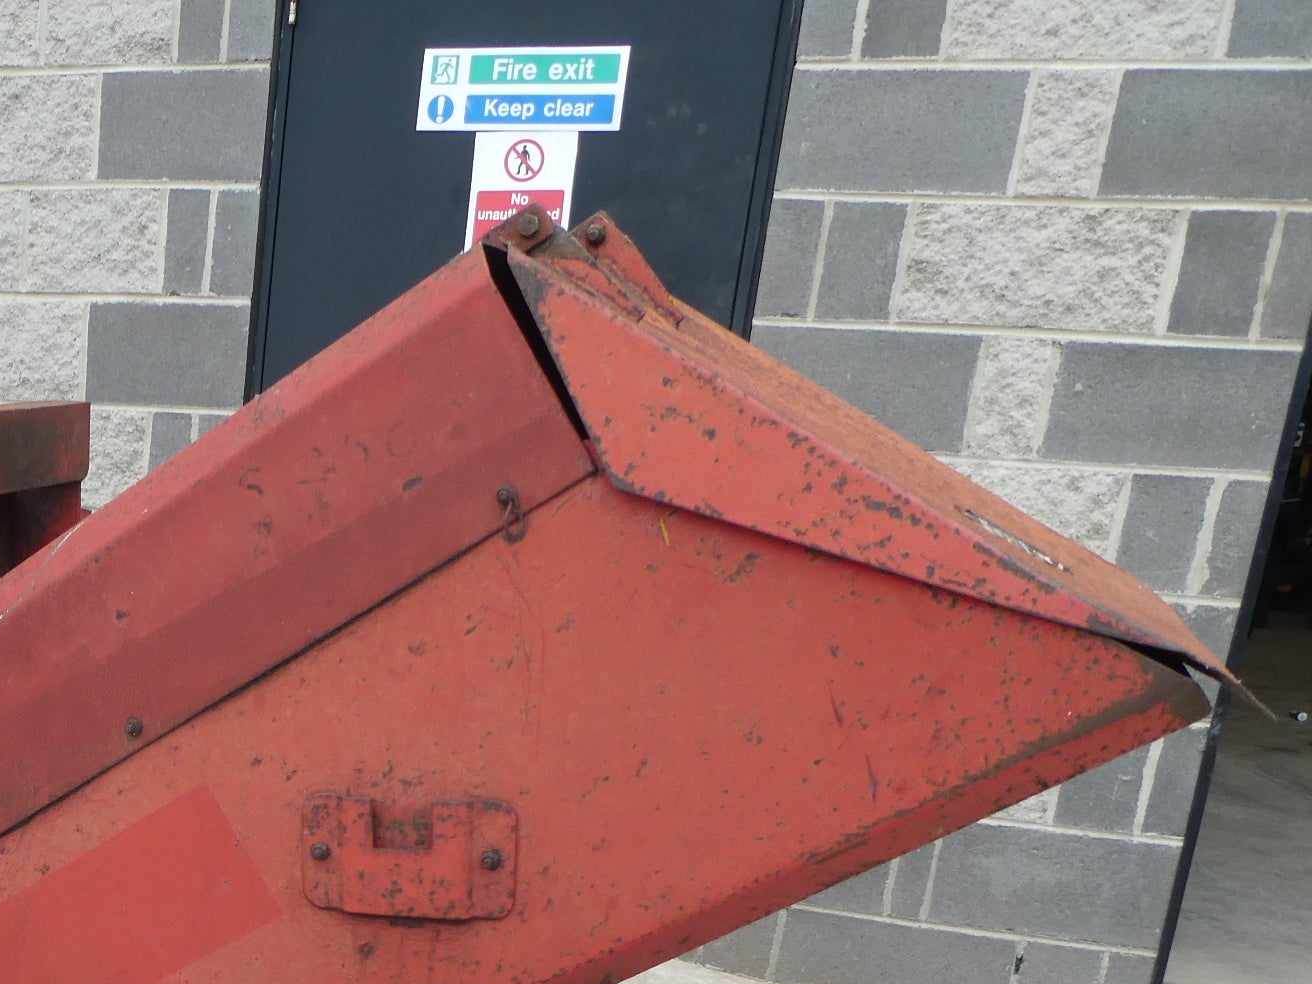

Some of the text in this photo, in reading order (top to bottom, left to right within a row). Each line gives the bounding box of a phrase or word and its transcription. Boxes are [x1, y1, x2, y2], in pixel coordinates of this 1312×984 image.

[492, 58, 595, 81] Fire exit
[484, 98, 594, 120] Keep clear
[510, 193, 529, 205] No
